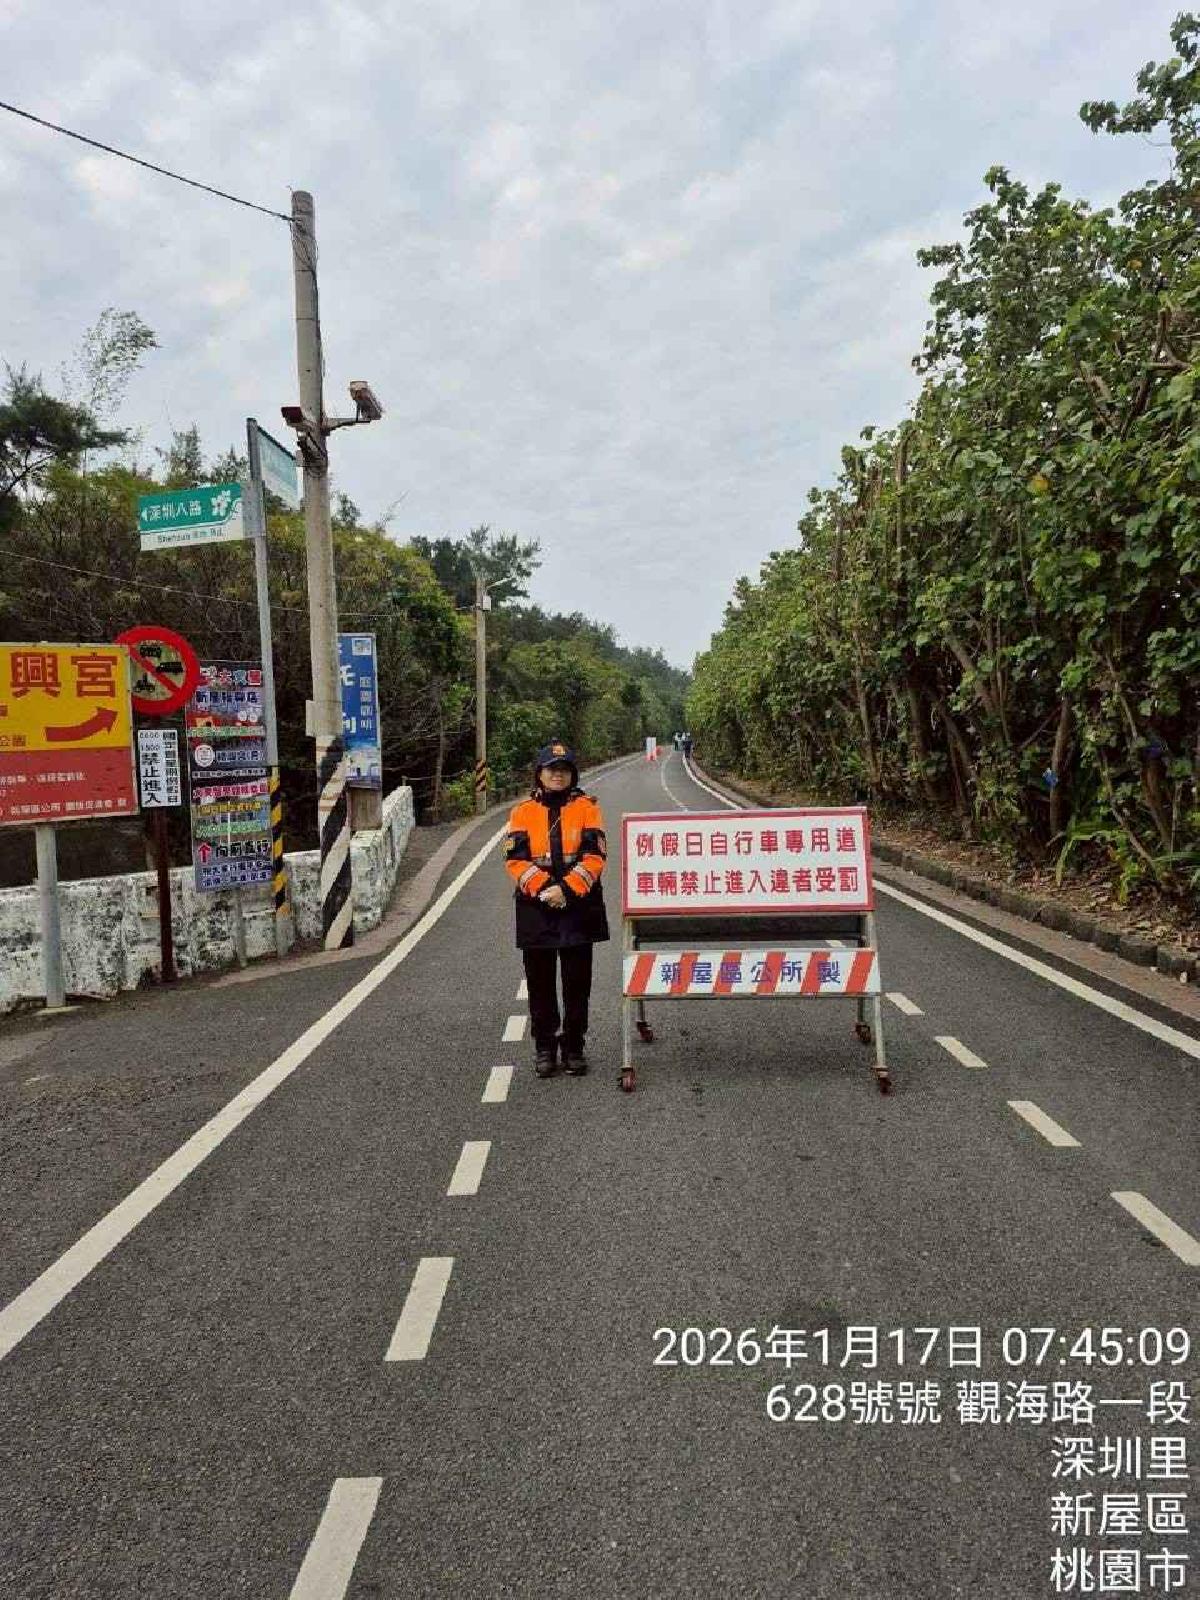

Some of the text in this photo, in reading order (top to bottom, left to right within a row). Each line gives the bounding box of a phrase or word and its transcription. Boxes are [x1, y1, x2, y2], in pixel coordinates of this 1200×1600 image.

[10, 651, 118, 698] 興宮
[141, 752, 161, 804] 禁止進入
[635, 826, 857, 858] 例假日自行車專用道
[635, 867, 859, 896] 車輛禁止進入違者受罰
